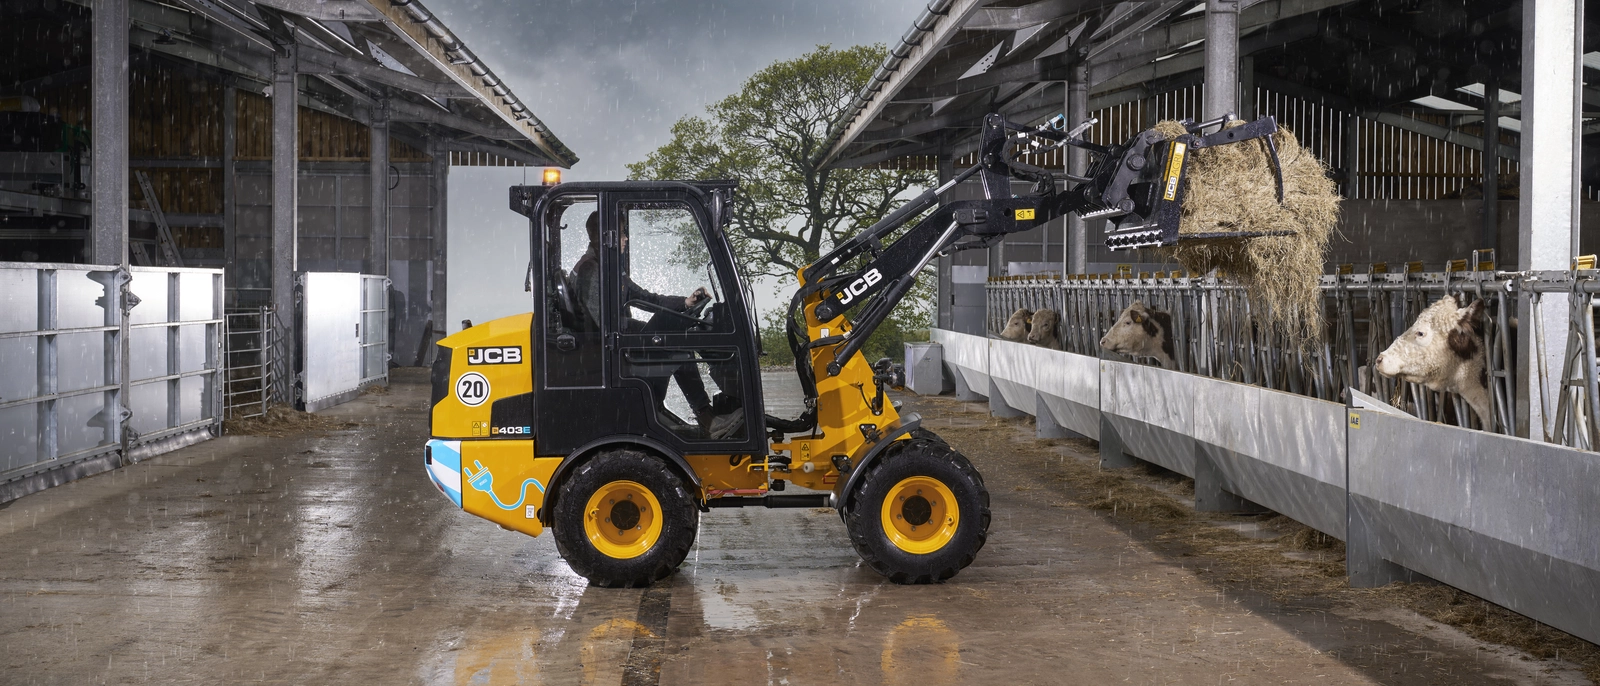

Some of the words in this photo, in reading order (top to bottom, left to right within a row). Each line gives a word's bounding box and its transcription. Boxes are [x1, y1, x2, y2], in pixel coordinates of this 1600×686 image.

[1171, 154, 1182, 176] AGRI
[1167, 177, 1177, 198] JCB
[840, 268, 882, 305] JCB
[468, 348, 522, 364] JCB
[462, 380, 484, 398] 20
